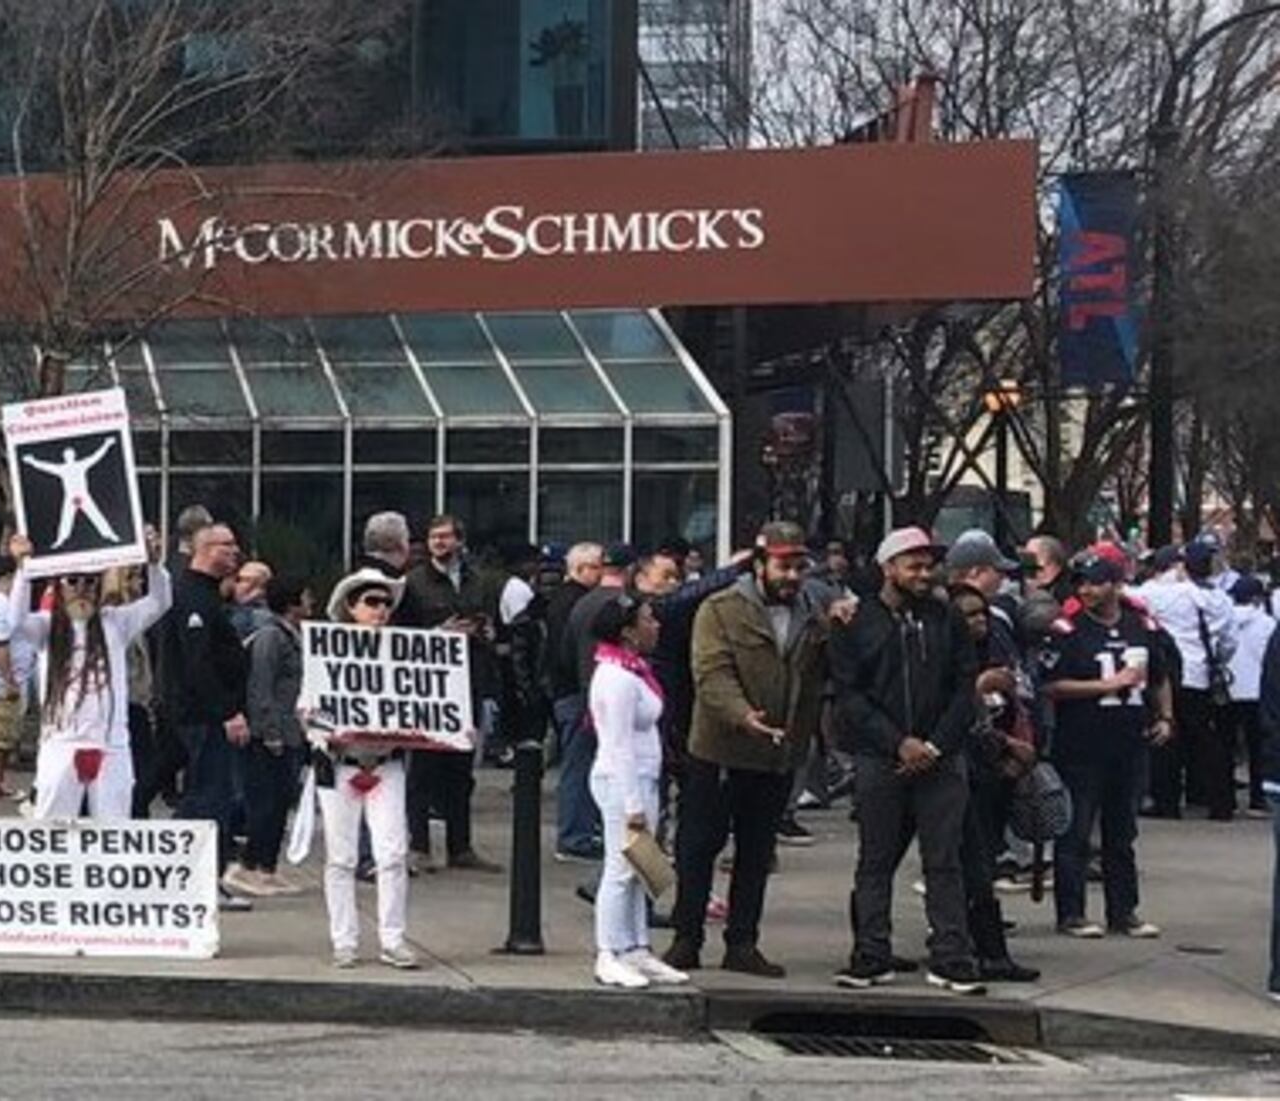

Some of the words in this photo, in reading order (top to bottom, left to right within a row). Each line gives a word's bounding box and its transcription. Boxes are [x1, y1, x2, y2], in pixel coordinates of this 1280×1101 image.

[309, 626, 382, 660] HOW
[390, 632, 464, 667] DARE
[325, 660, 384, 695] YOU
[393, 666, 451, 699] CUT
[319, 694, 370, 727] HIS
[377, 697, 462, 733] PENIS
[79, 829, 195, 854] PENIS?
[84, 864, 192, 890] BODY?
[69, 902, 208, 928] RIGHTS?
